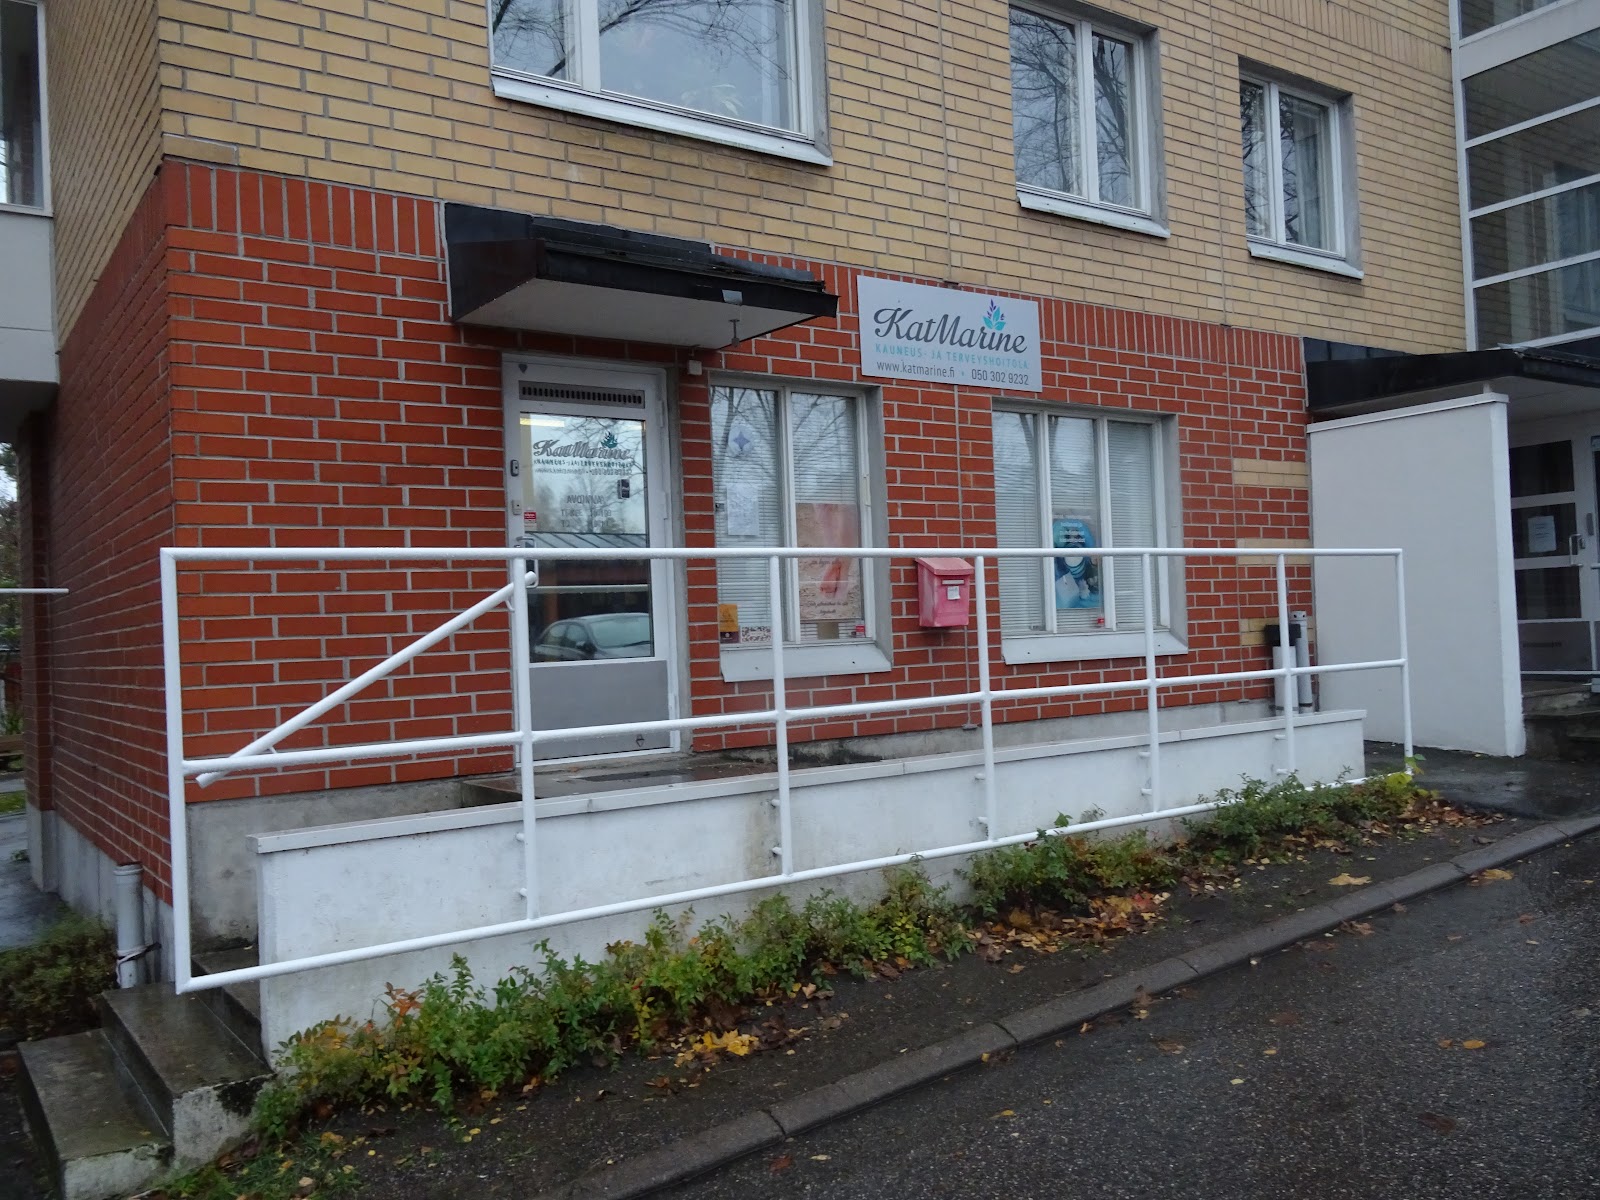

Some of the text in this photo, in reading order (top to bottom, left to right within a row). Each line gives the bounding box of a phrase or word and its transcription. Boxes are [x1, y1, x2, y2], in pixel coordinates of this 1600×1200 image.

[873, 307, 1028, 354] KatMarine
[875, 343, 1029, 369] KAUNEUS- JA TERVEYSHOITOLA
[877, 360, 1029, 386] www.katmarine.fi 050 302 9232
